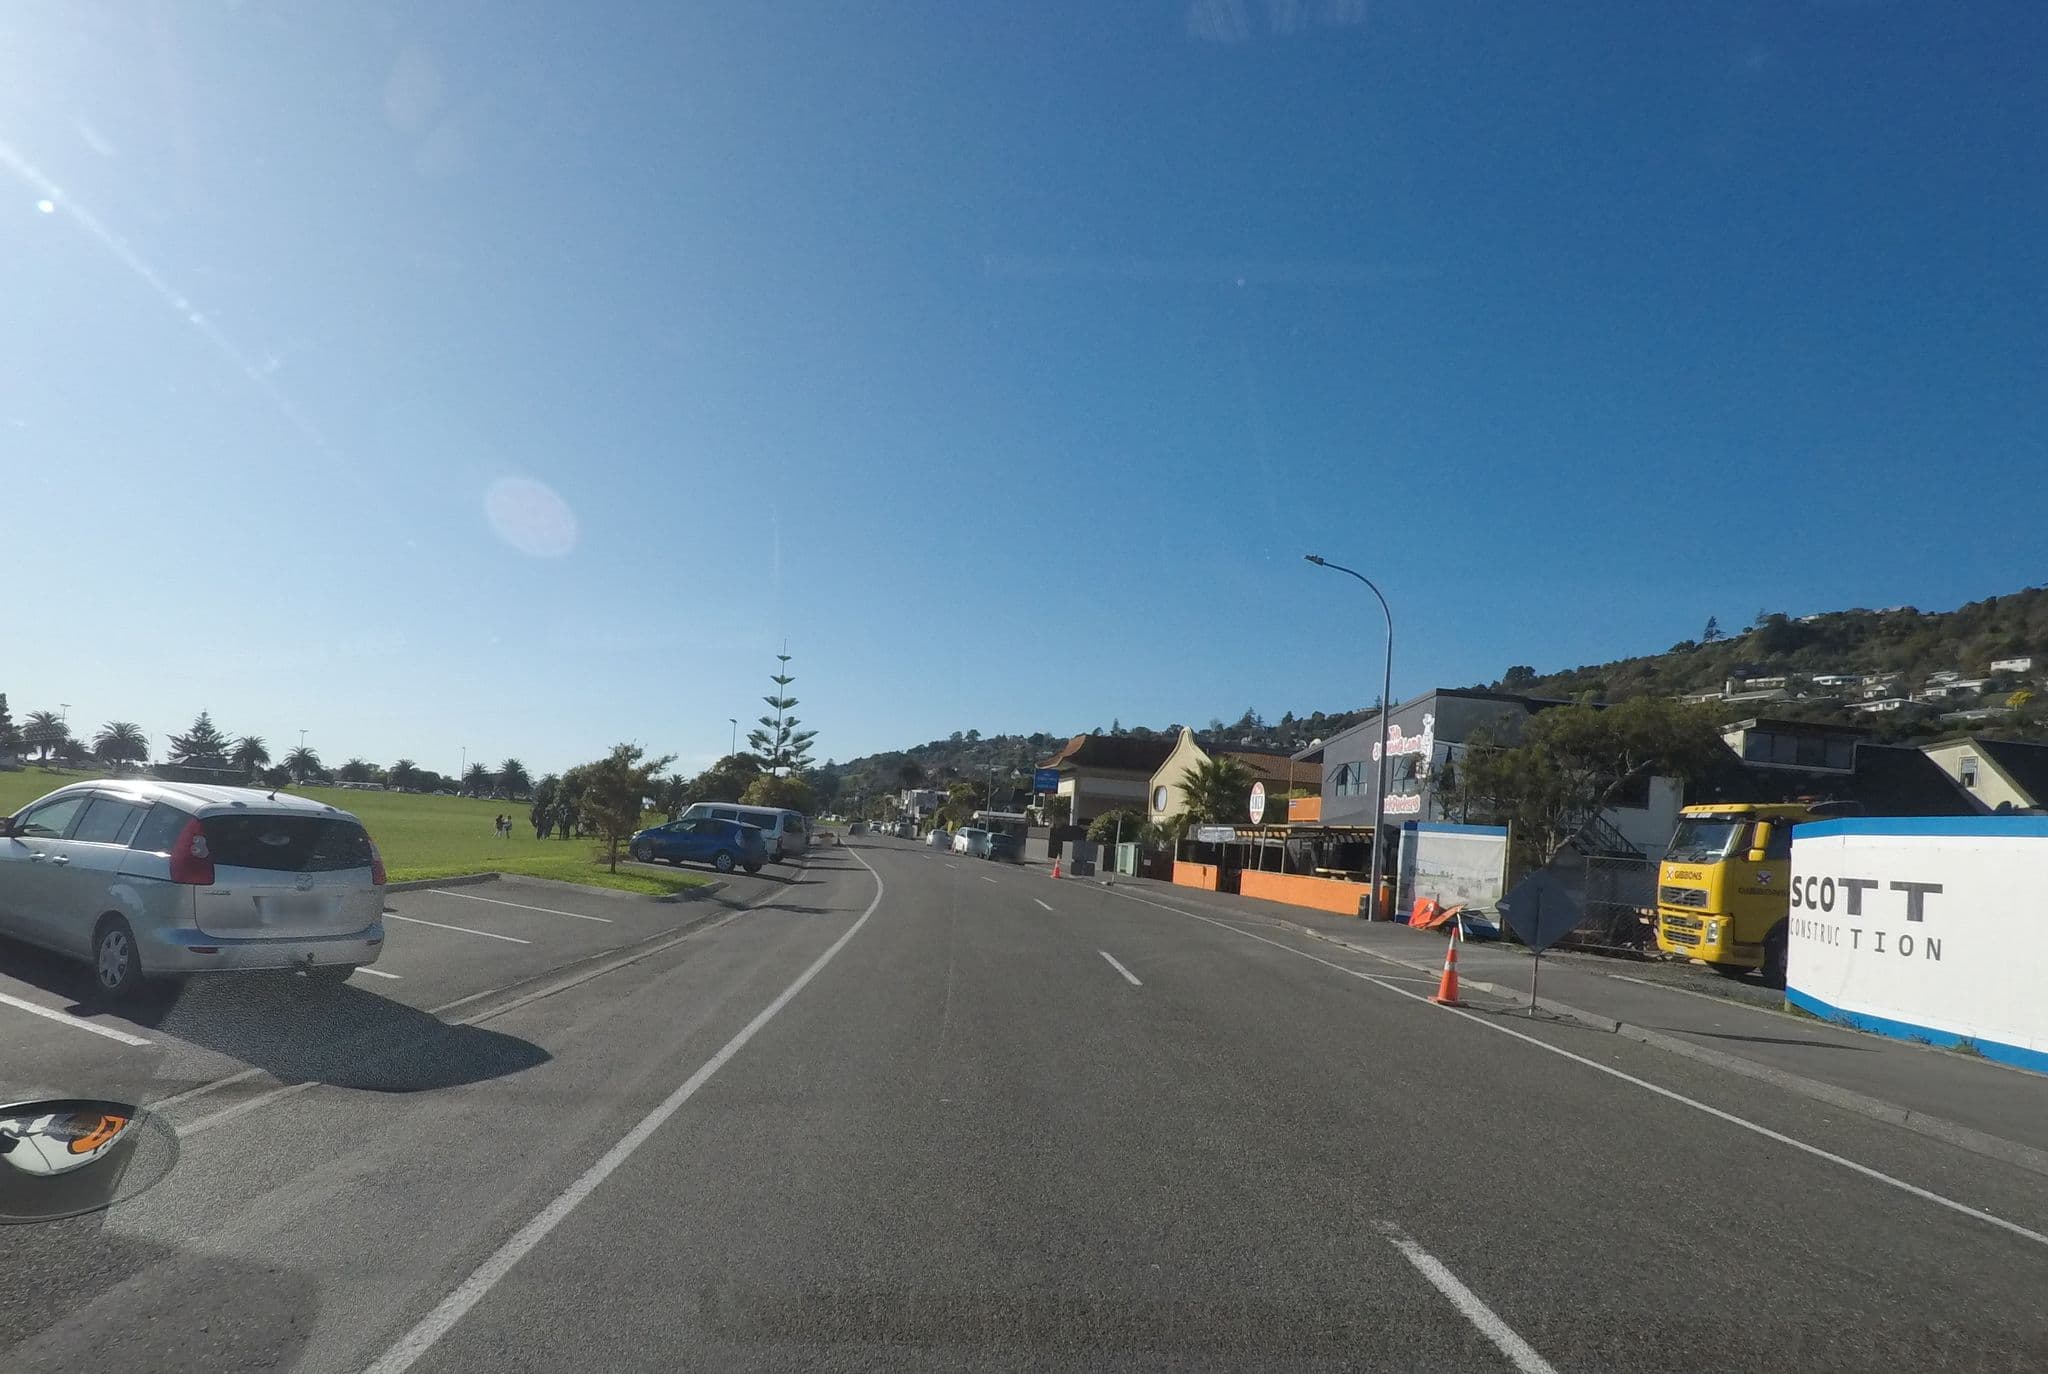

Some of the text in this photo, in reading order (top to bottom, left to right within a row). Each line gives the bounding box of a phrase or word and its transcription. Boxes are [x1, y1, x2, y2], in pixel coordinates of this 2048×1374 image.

[1674, 870, 1703, 881] GIBBONS
[1791, 875, 1943, 922] SCOTT
[1790, 917, 1942, 961] CONSTRUCTION
